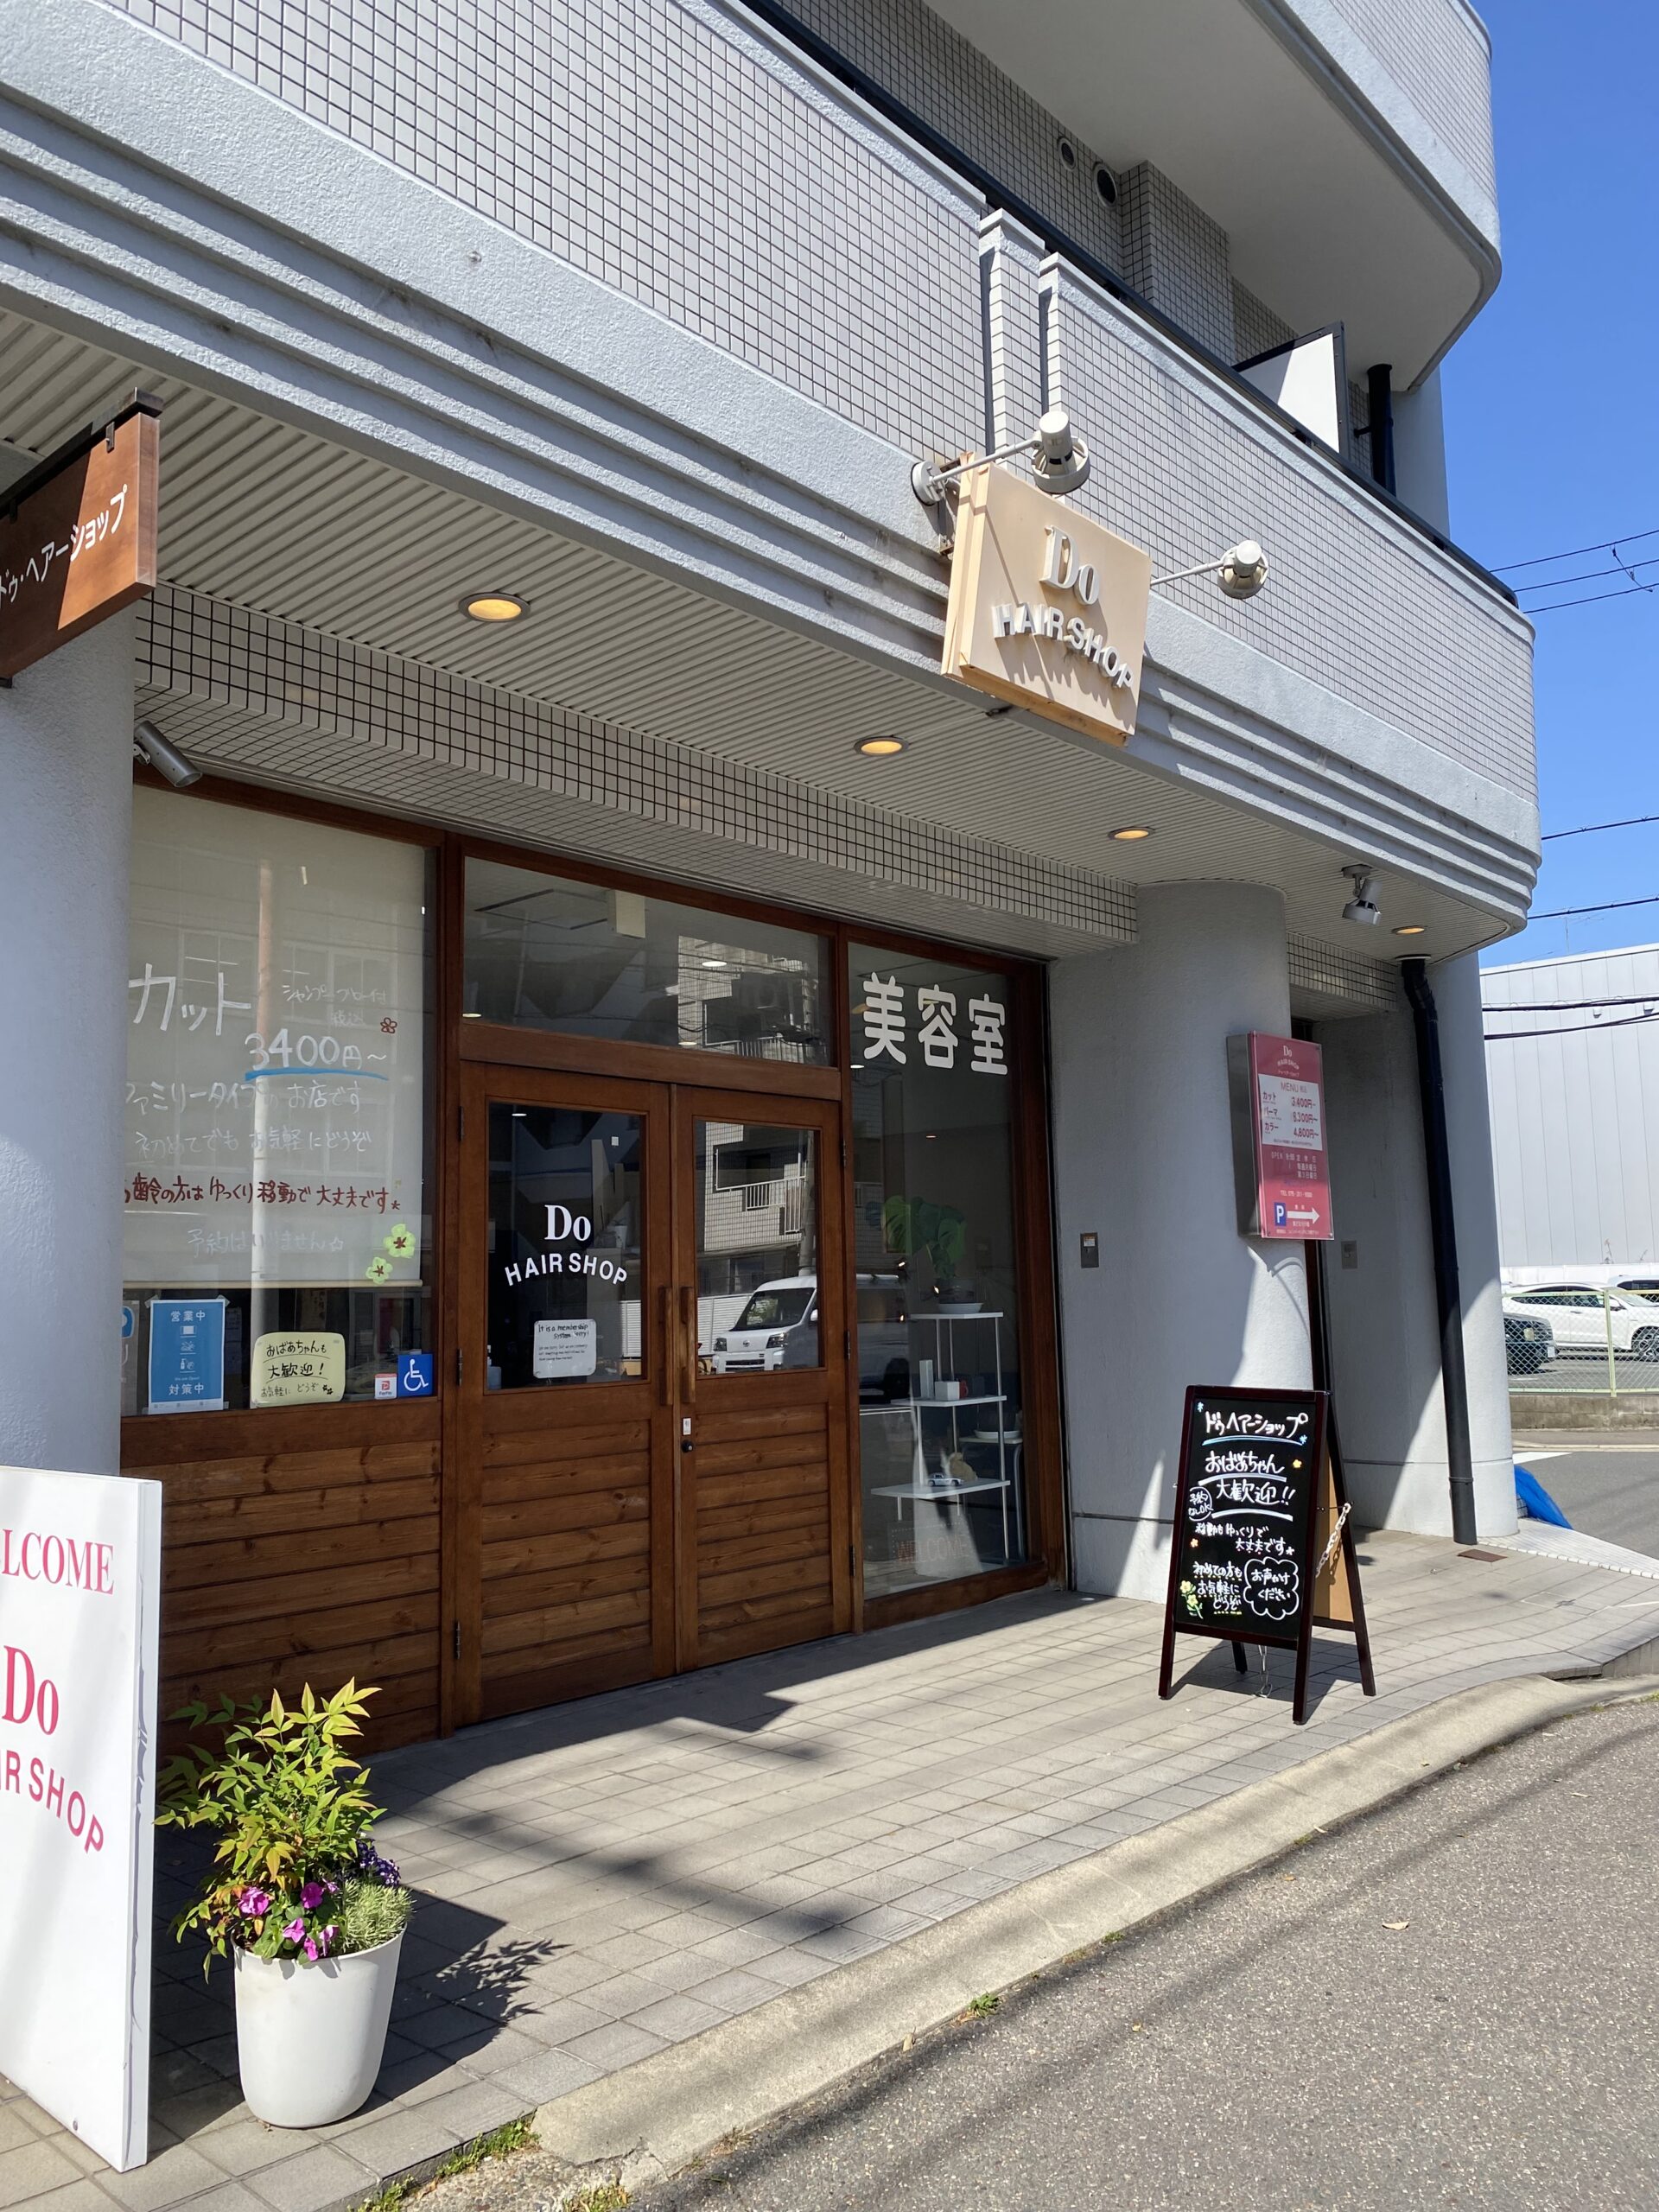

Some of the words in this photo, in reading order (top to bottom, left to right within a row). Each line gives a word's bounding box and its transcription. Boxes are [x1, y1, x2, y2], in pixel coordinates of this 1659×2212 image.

[1039, 524, 1100, 605] Do
[991, 601, 1064, 641] HAIR
[1064, 616, 1135, 689] SHOP
[129, 963, 251, 1036] カット
[863, 971, 1008, 1075] 美容室
[1283, 1045, 1292, 1057] Do
[1262, 1090, 1276, 1101] カット
[544, 1205, 591, 1242] Do
[505, 1252, 563, 1287] HAIR
[568, 1252, 627, 1285] SHOP
[170, 1309, 206, 1323] 営業中
[266, 1340, 327, 1357] おばあちゃんも
[168, 1382, 204, 1396] 対策中
[1205, 1410, 1309, 1439] ドゥヘアーショップ
[1205, 1450, 1285, 1474] おばあちゃん
[2, 1529, 114, 1595] LCOME
[1192, 1560, 1243, 1579] 初めての方も
[1197, 1580, 1240, 1596] お気軽に
[1250, 1567, 1291, 1586] お声かけ
[1212, 1596, 1242, 1611] どうぞ
[1257, 1586, 1292, 1602] ください
[2, 1646, 59, 1736] Do
[29, 1757, 105, 1854] SHOP
